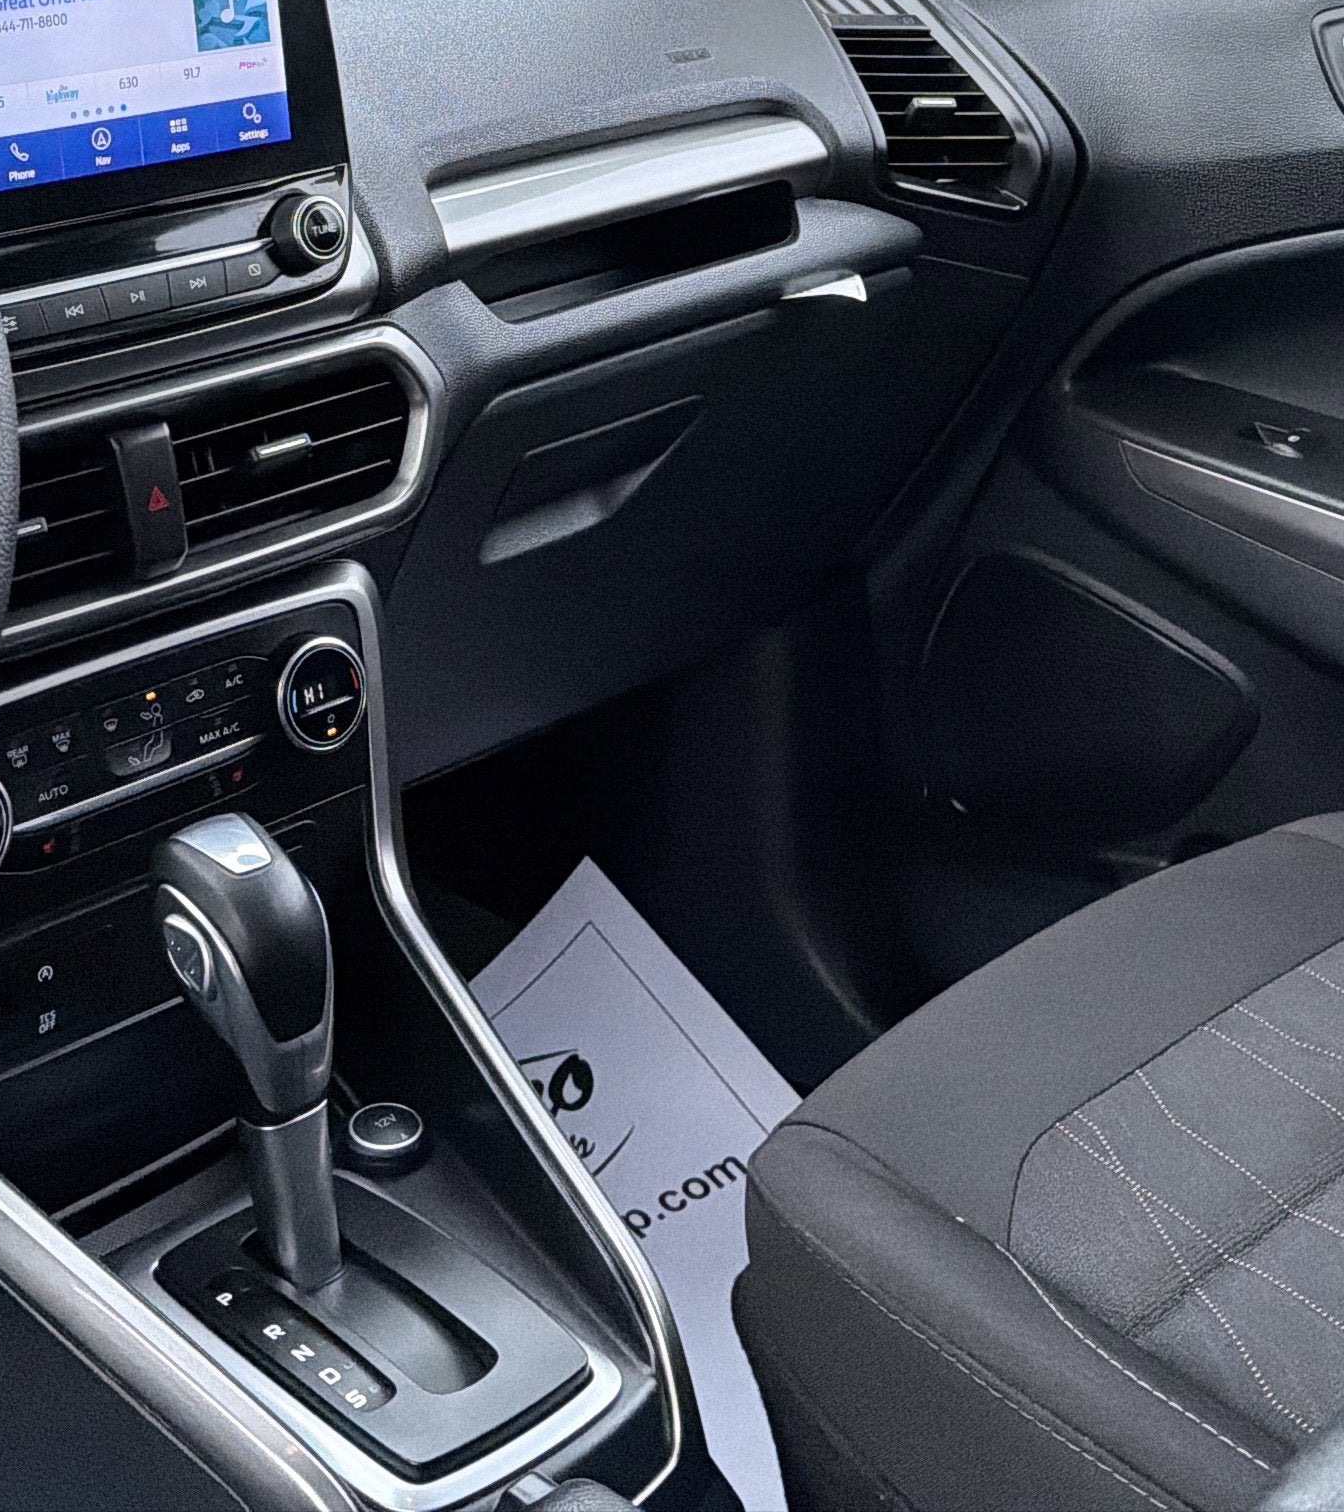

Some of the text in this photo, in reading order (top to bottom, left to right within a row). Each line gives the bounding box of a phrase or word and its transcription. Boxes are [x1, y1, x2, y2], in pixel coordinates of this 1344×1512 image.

[183, 66, 201, 80] 91.7
[119, 76, 139, 90] 630
[46, 88, 79, 104] highway
[239, 129, 269, 142] Settings
[171, 142, 191, 154] Apps
[95, 156, 112, 167] Nav
[9, 169, 36, 182] Phone
[225, 674, 244, 688] A/C
[199, 721, 241, 744] MAX A/C
[6, 745, 29, 759] REAR
[38, 784, 69, 802] AUTO
[374, 1113, 397, 1128] 12V
[215, 1292, 367, 1409] P R N D S
